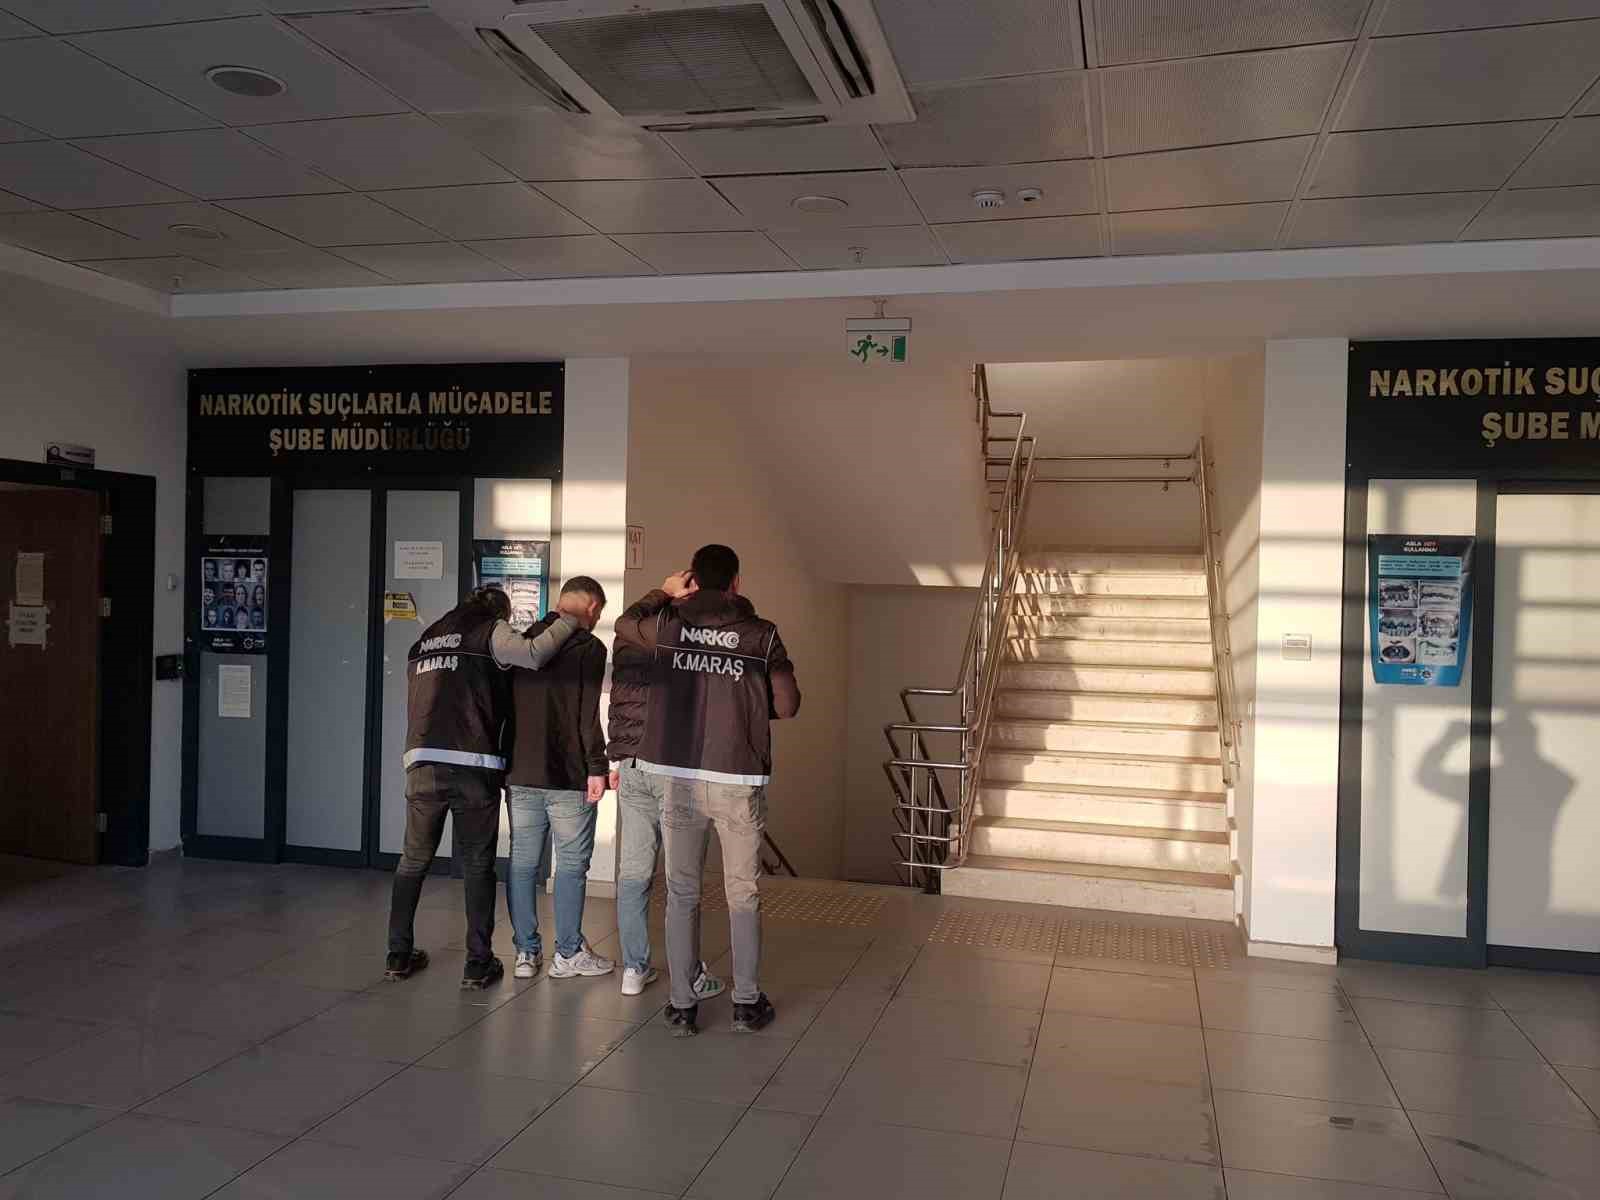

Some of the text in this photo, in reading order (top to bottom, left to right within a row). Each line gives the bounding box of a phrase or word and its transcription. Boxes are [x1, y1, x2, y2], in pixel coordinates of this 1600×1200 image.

[1369, 361, 1536, 397] NARKOTİK
[200, 385, 553, 421] NARKOTİK SUÇLARLA MÜCADELE
[269, 421, 470, 456] ŞUBE MÜDÜRLÜĞÜ
[1481, 411, 1570, 447] ŞUBE
[672, 652, 744, 681] K.MARAŞ
